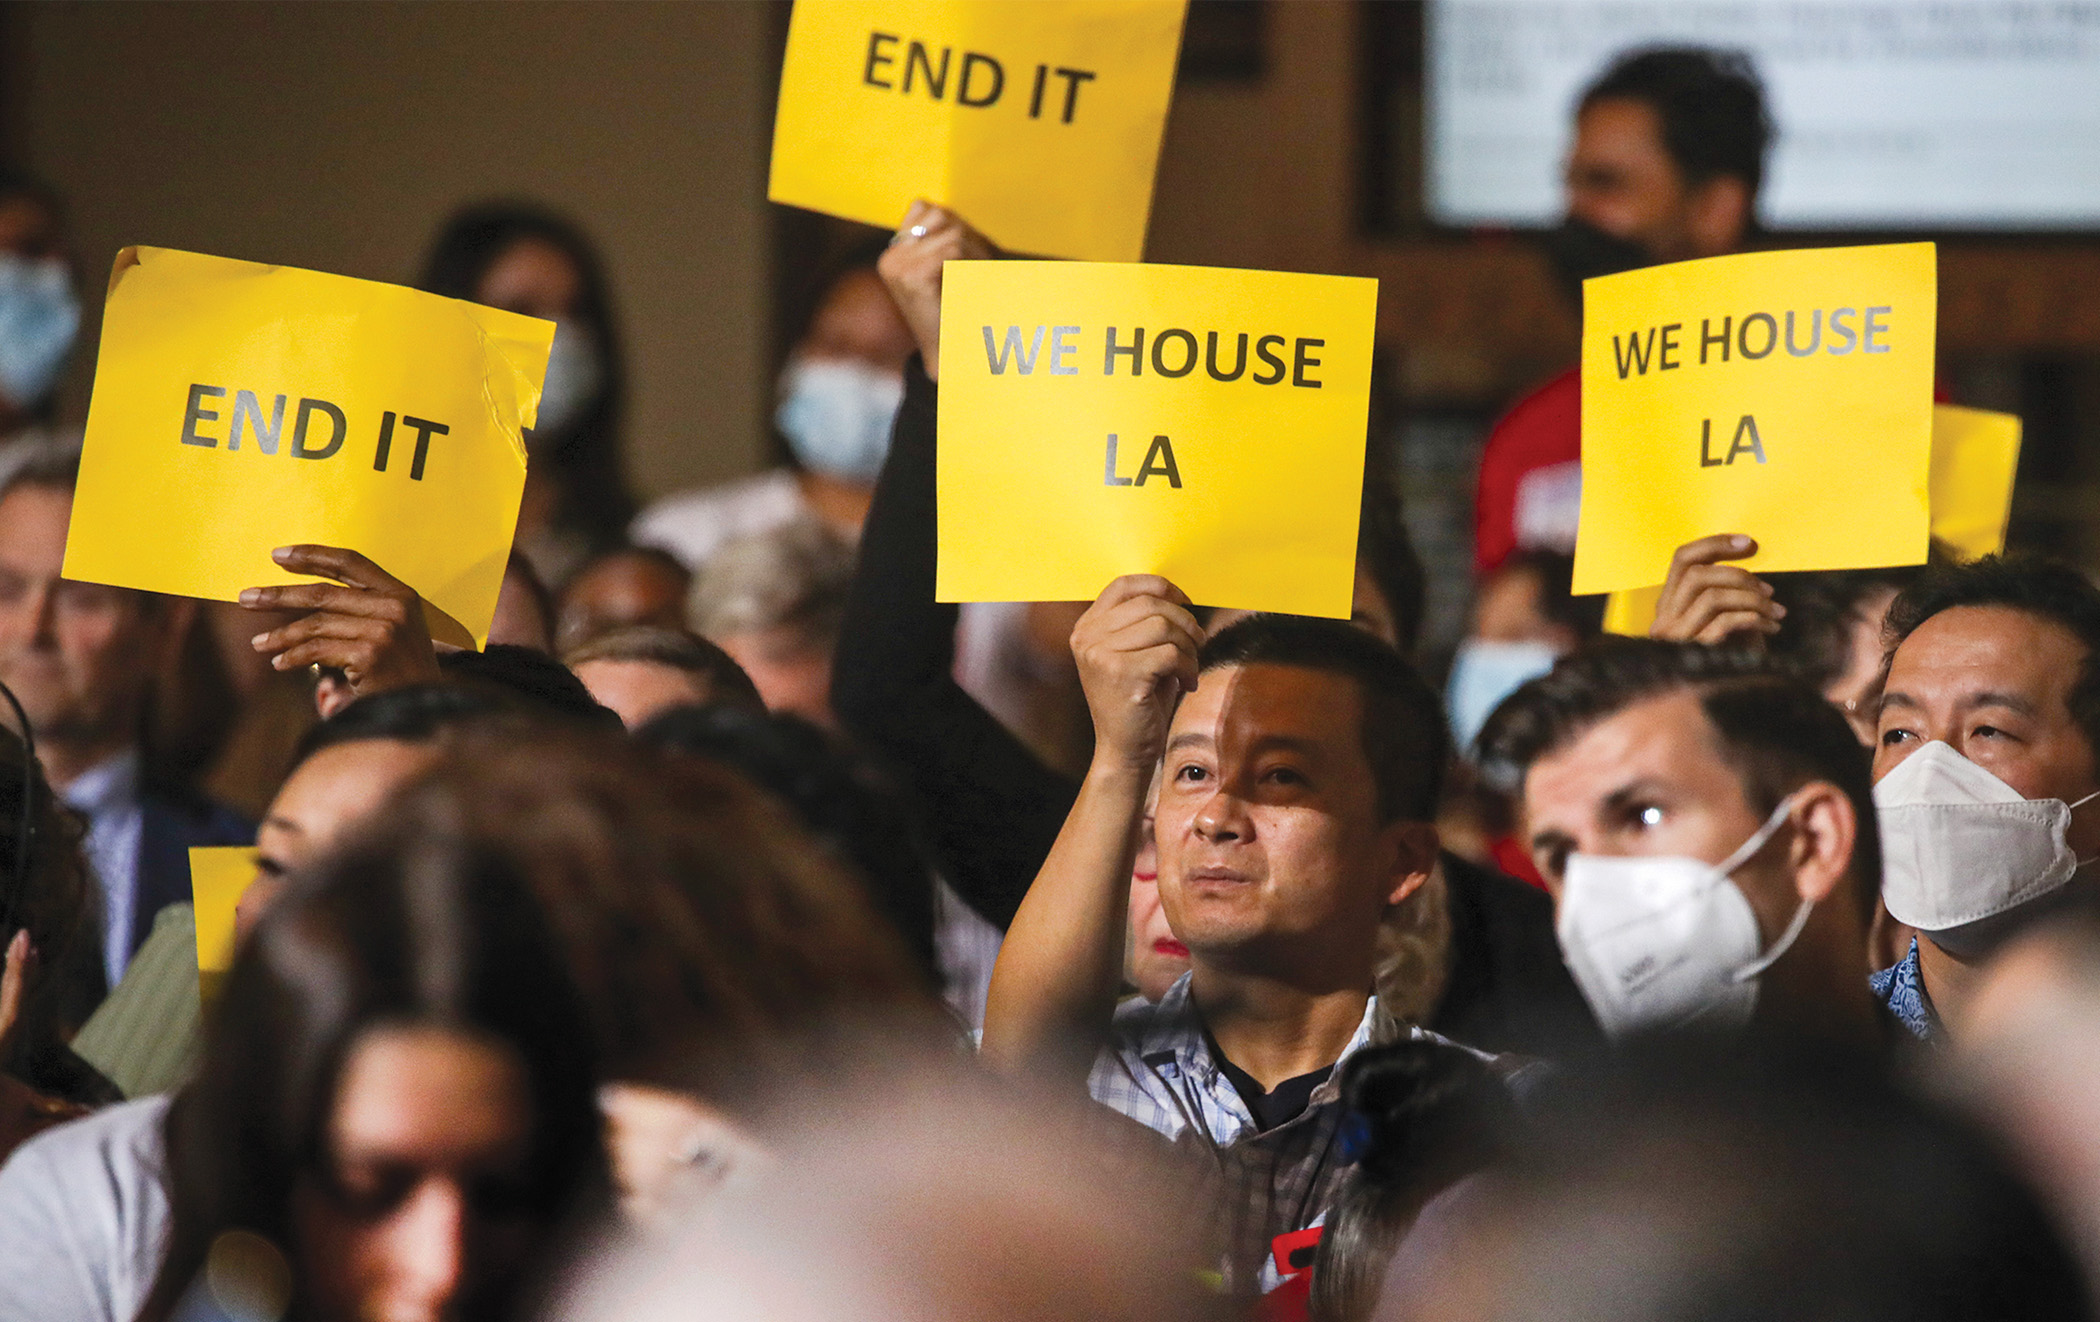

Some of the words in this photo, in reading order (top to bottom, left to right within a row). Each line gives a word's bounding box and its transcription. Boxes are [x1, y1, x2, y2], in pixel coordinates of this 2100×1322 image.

[863, 31, 1004, 108] END
[1027, 64, 1095, 125] IT
[982, 325, 1081, 376] WE
[1103, 327, 1325, 389] HOUSE
[1612, 322, 1682, 380] WE
[1699, 305, 1893, 365] HOUSE
[180, 383, 348, 460] END
[373, 411, 450, 482] IT
[1103, 433, 1183, 489] LA
[1699, 415, 1766, 468] LA
